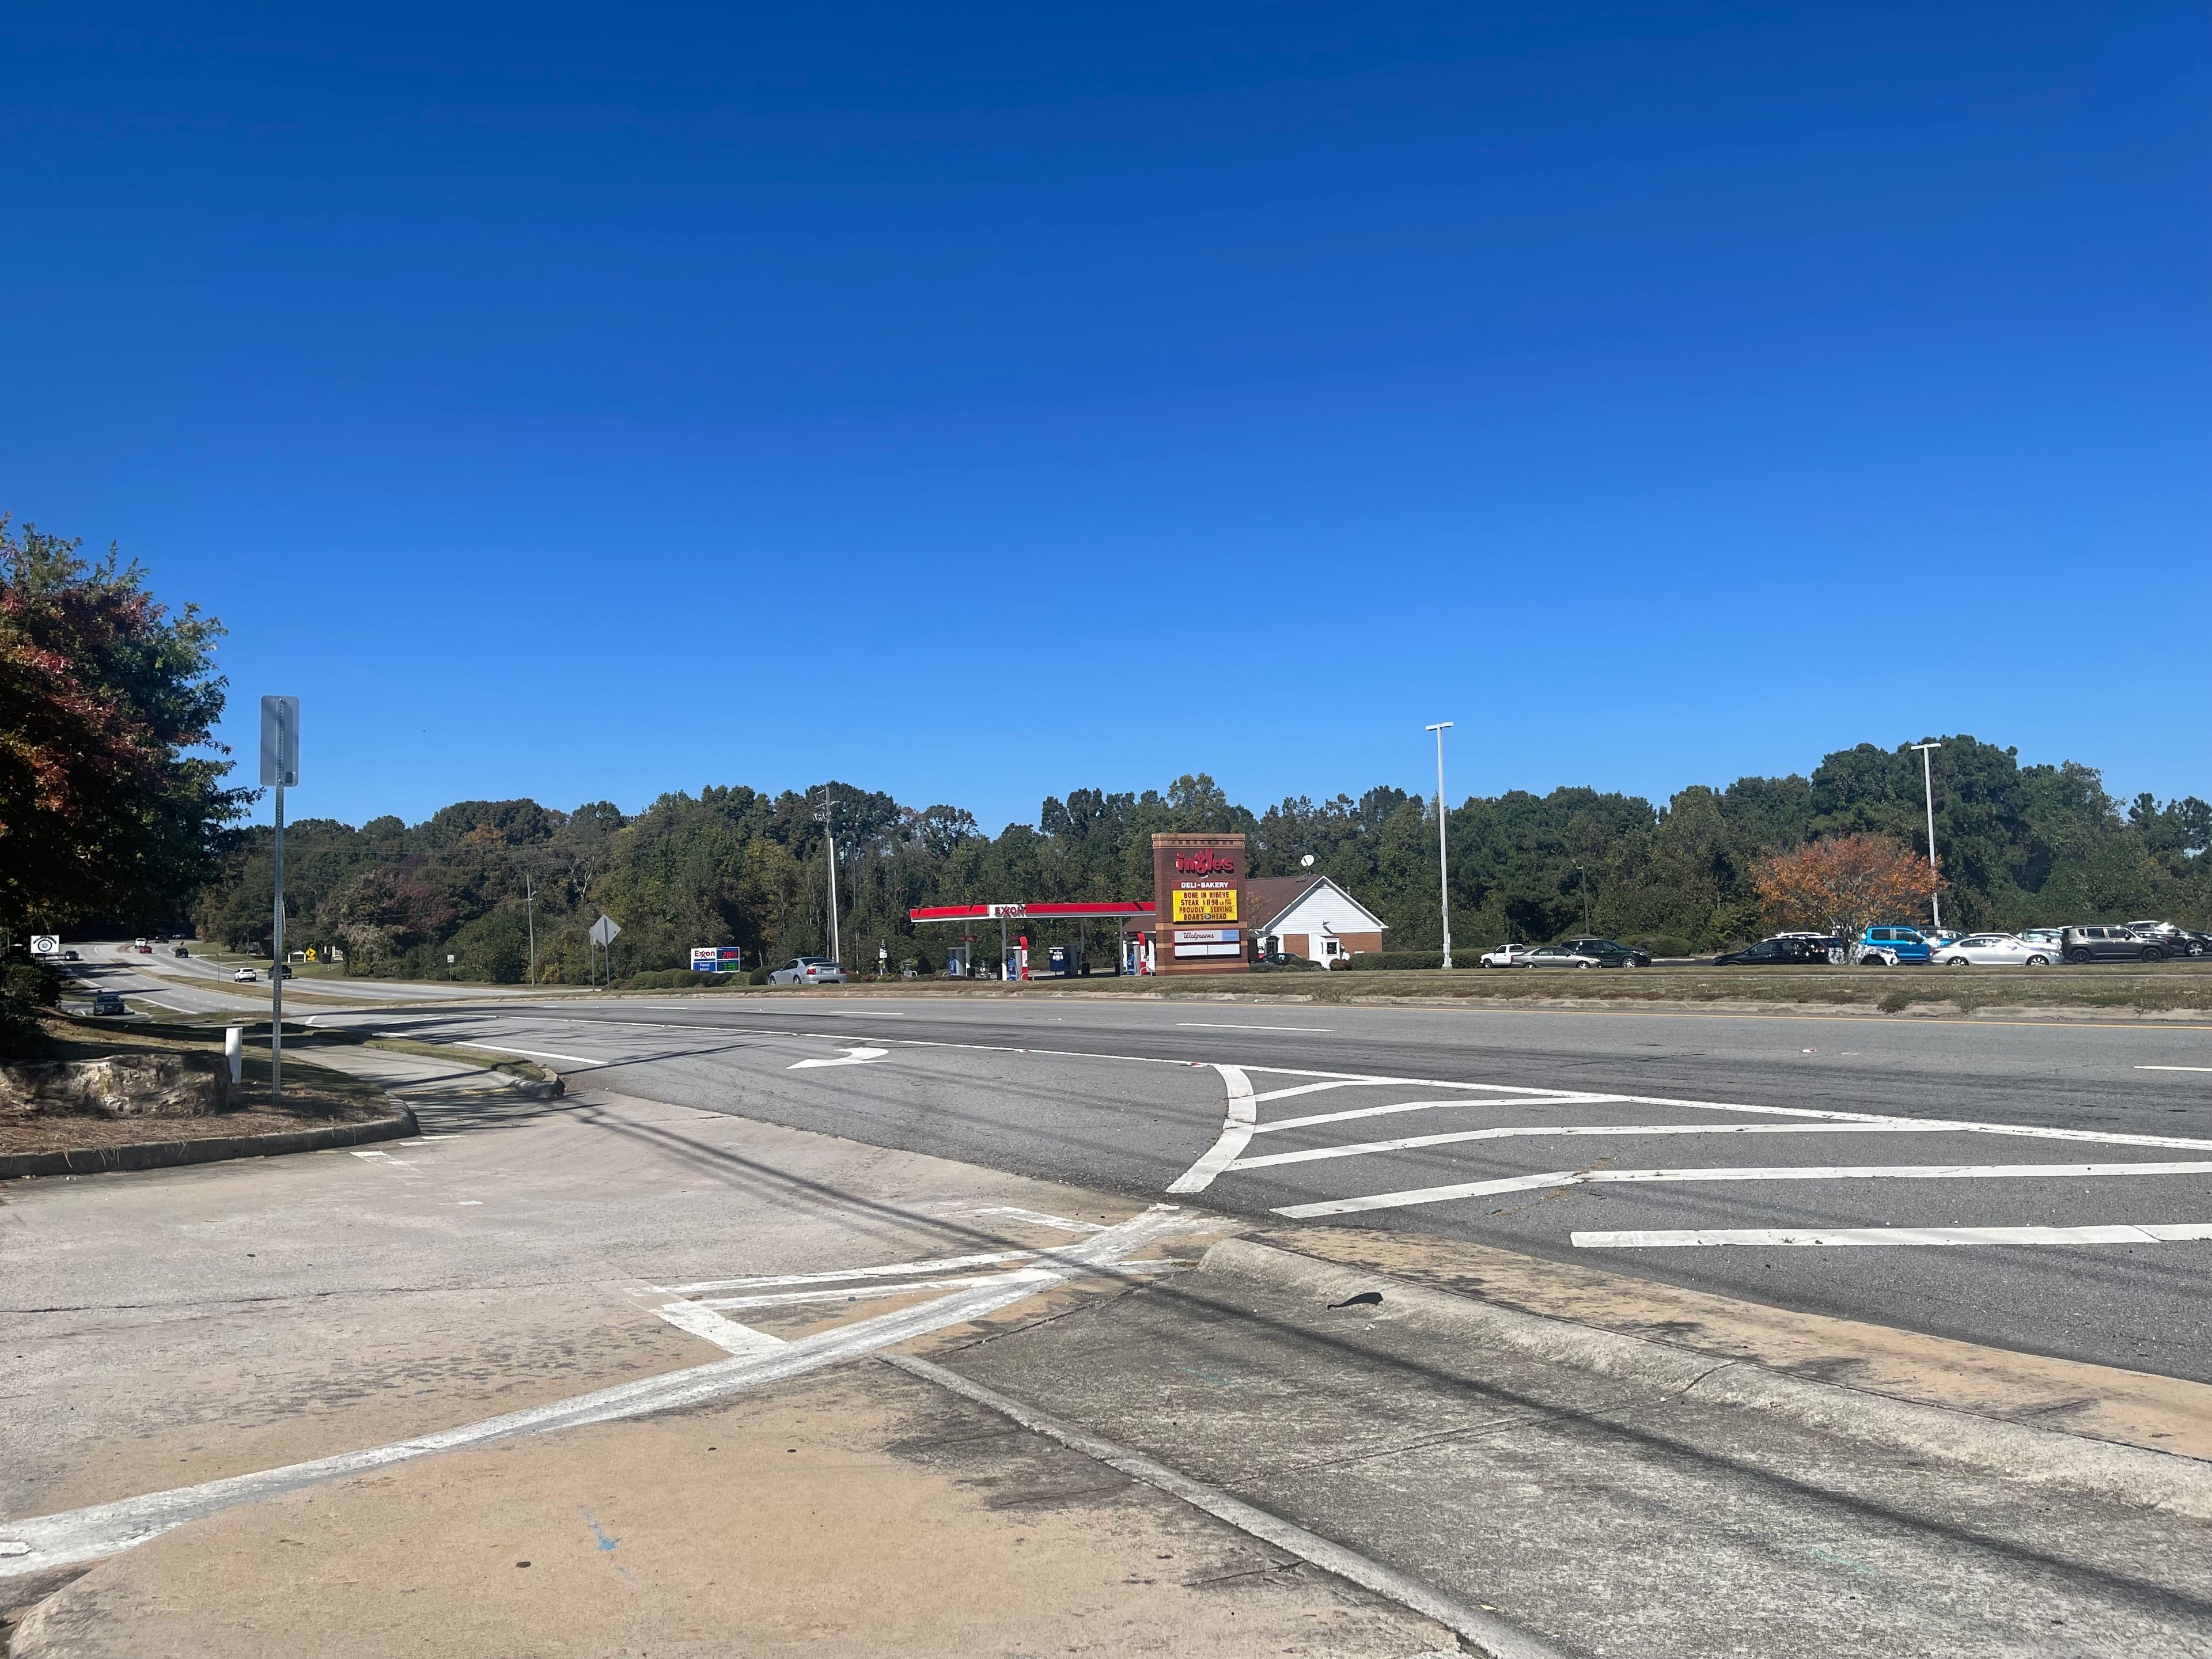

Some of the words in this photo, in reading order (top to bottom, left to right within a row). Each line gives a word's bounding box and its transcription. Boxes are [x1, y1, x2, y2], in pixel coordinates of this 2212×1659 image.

[1176, 849, 1234, 874] ingles
[995, 906, 1027, 918] EXXON
[1183, 932, 1215, 940] Walgreens
[695, 950, 715, 959] Exxon
